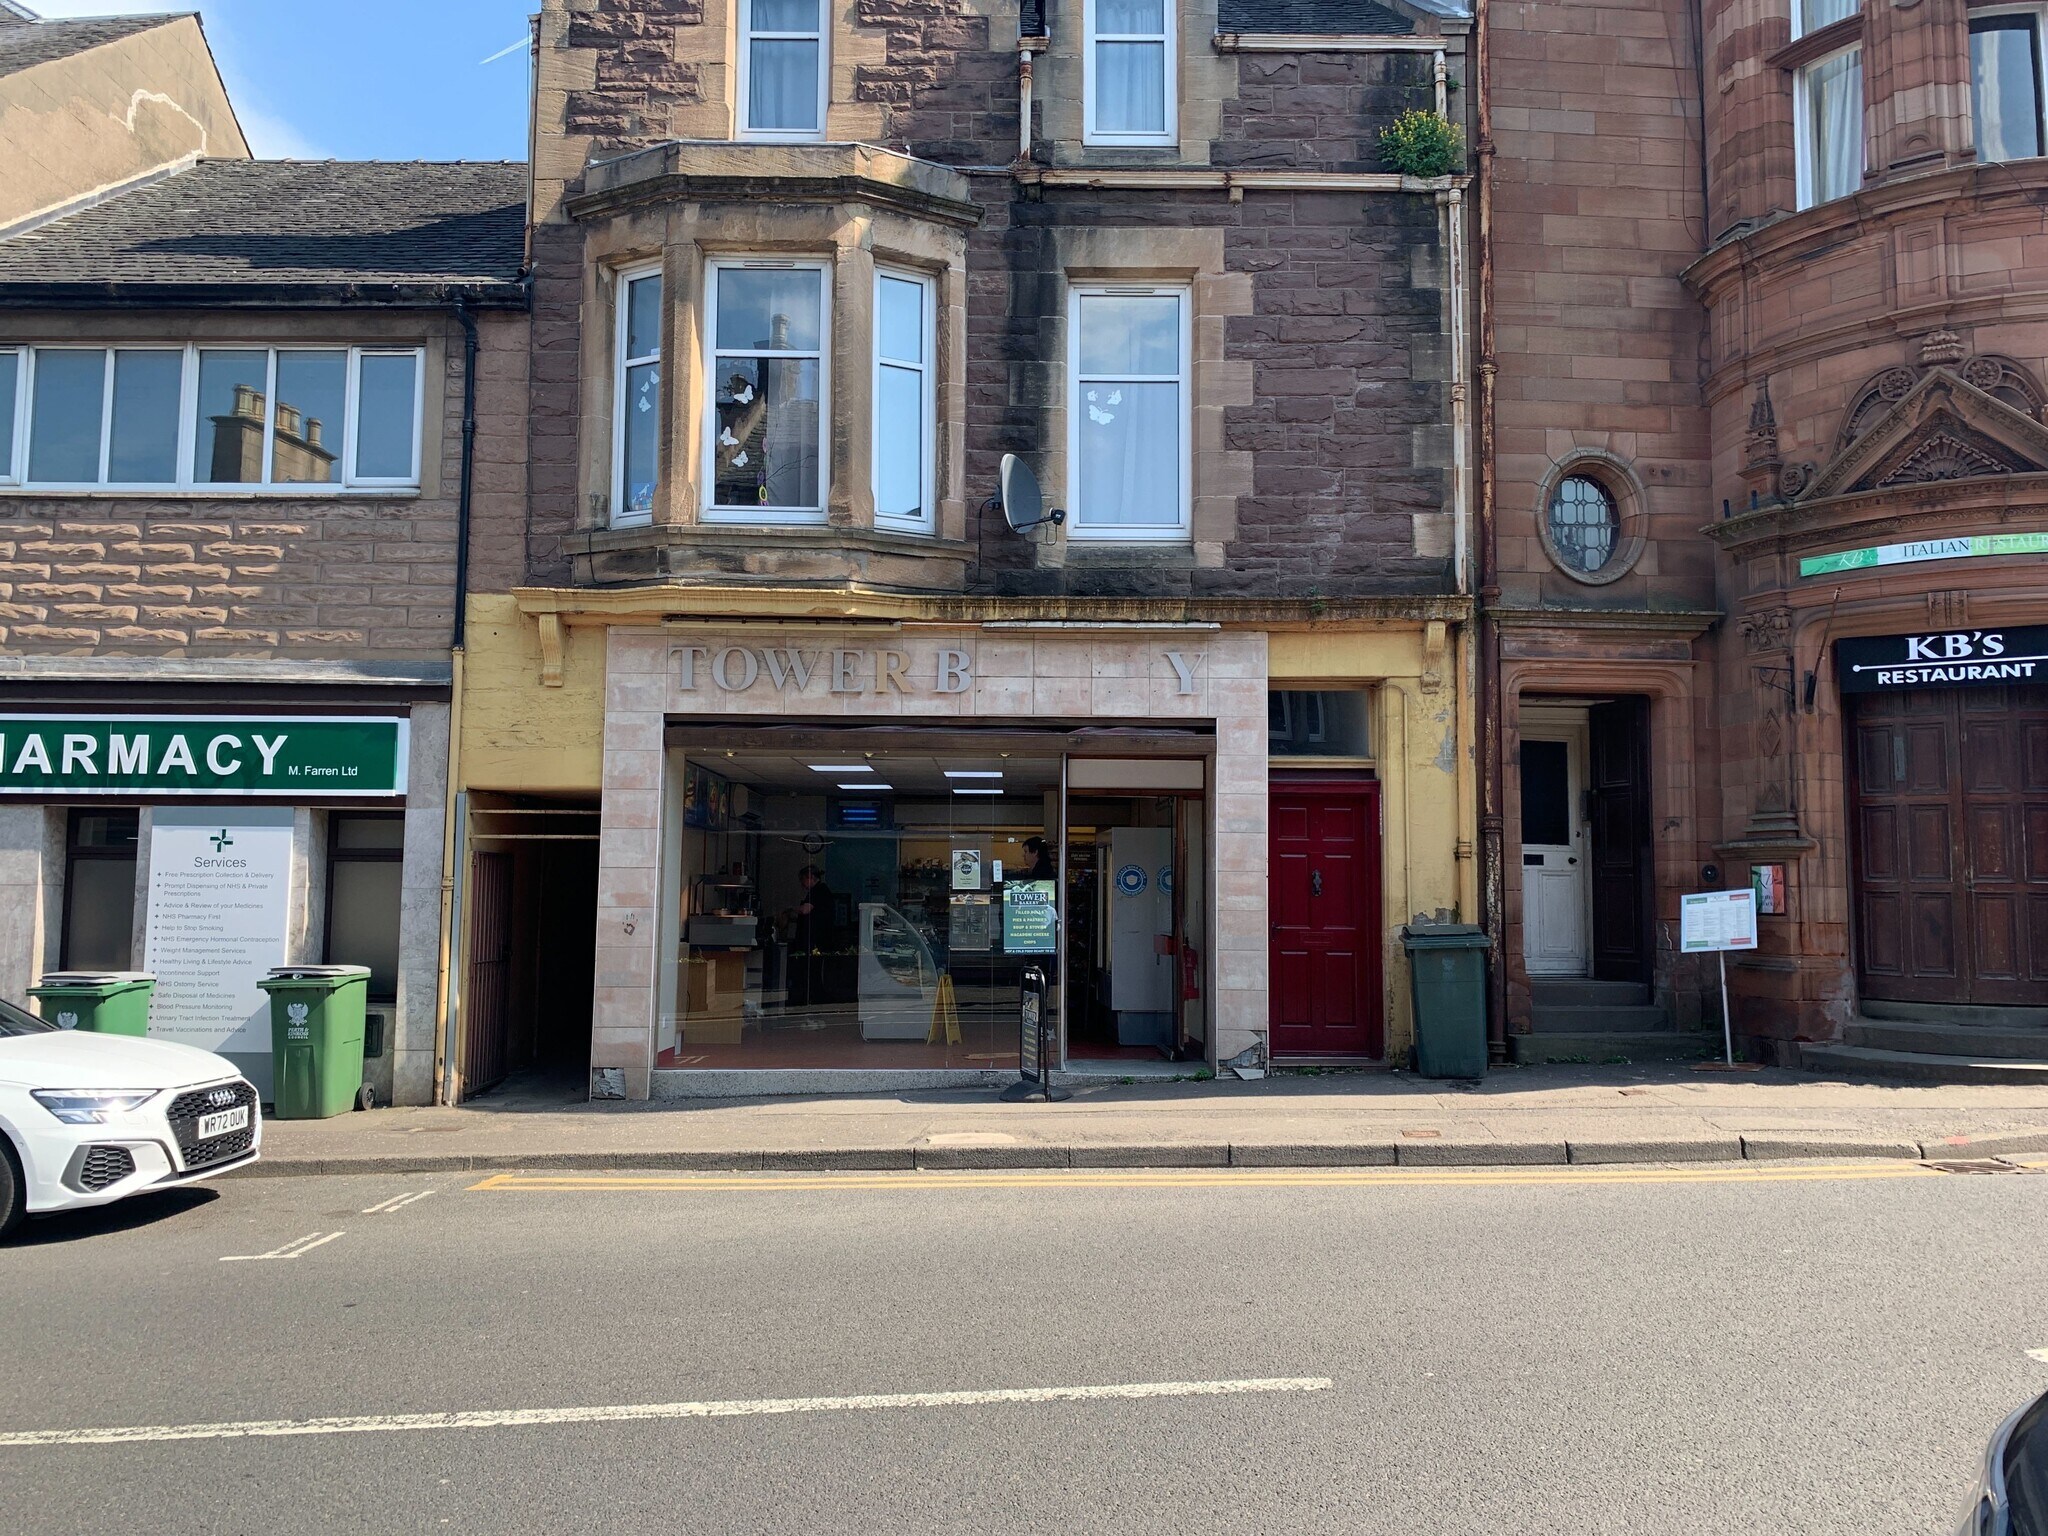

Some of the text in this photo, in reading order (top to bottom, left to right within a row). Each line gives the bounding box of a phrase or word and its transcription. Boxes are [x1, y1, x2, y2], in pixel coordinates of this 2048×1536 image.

[1904, 539, 1970, 557] ITALIAN
[1906, 632, 2004, 661] KB'S
[667, 647, 914, 694] TOWER
[1878, 662, 2036, 685] RESTAURANT
[288, 766, 358, 776] M. Farren Ltd
[194, 857, 247, 868] Services
[1012, 894, 1046, 902] TOWER
[205, 1114, 228, 1134] WR72
